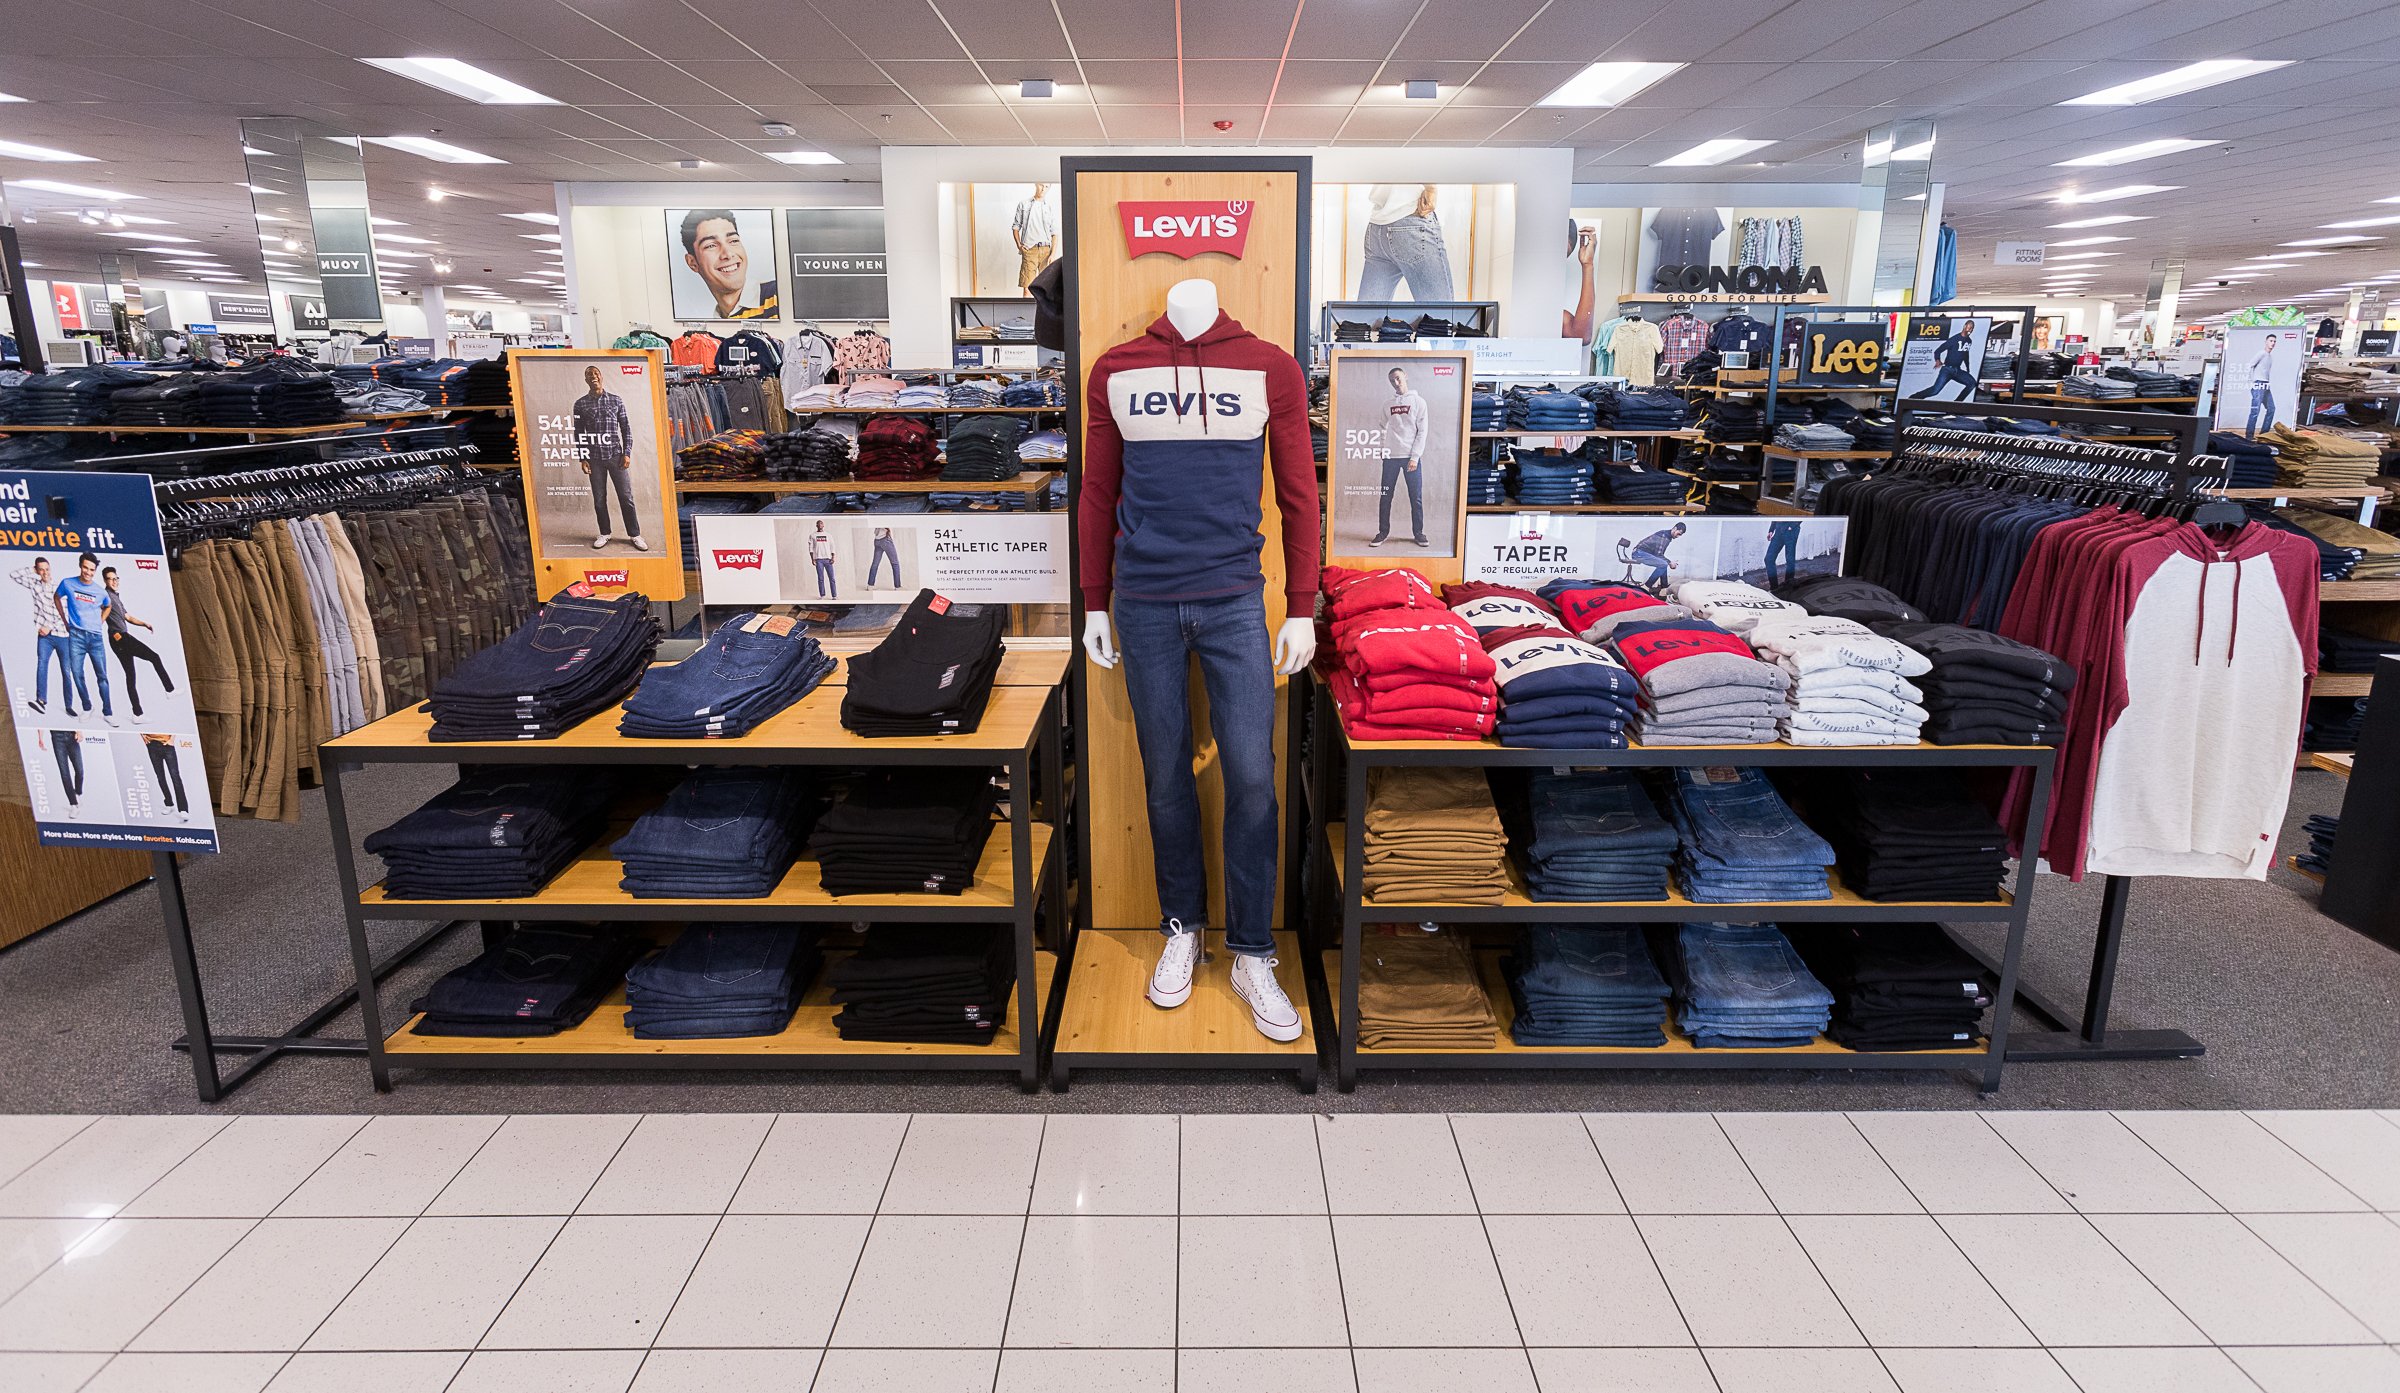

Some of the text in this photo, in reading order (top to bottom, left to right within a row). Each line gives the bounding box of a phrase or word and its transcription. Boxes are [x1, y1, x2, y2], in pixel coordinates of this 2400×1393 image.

[803, 260, 883, 270] YOUNG MEN
[2015, 255, 2041, 263] ROOMS
[1654, 264, 1829, 294] SONOMA
[1666, 294, 1798, 303] GOODS FOR LIFE
[222, 305, 267, 315] MEN'S BASICS
[1920, 323, 1941, 336] Lee
[1811, 333, 1880, 375] Lee
[2226, 382, 2270, 390] STRAIGHT
[540, 433, 612, 445] ATHLETIC
[541, 447, 591, 460] TAPER
[1344, 448, 1392, 460] TAPER
[87, 527, 124, 549] fit.
[935, 542, 1048, 553] ATHLETIC TAPER
[1493, 545, 1568, 562] TAPER
[1503, 566, 1546, 574] REGULAR
[1549, 566, 1578, 574] TAPER
[1839, 646, 1854, 659] SAN
[1808, 713, 1821, 726] SAN
[1865, 718, 1876, 728] CA
[179, 739, 193, 748] Lee
[30, 759, 50, 814] Straight
[134, 764, 153, 819] straight
[43, 830, 62, 838] More
[83, 832, 101, 840] More
[143, 834, 175, 843] favorites.
[175, 836, 212, 845] Kohls.com
